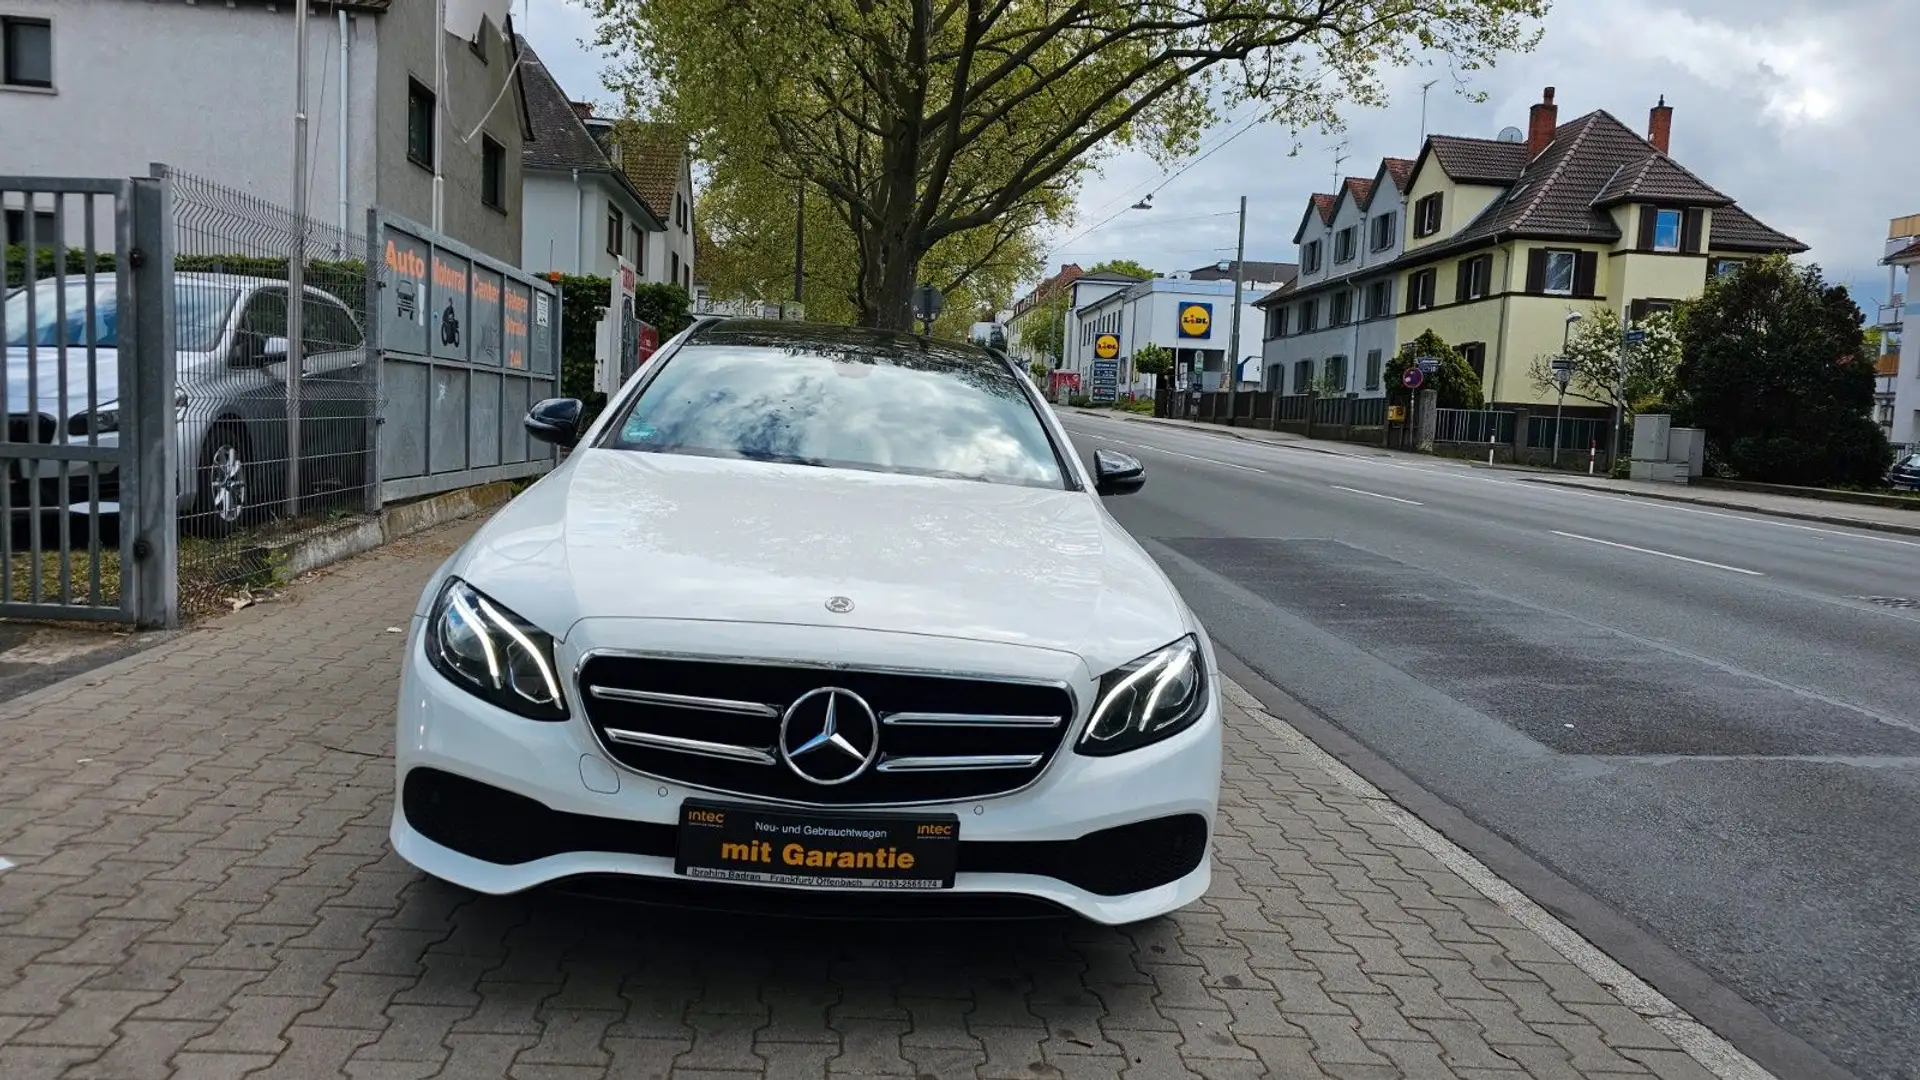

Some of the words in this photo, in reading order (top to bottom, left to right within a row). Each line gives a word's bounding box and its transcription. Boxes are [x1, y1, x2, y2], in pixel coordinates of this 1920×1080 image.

[385, 239, 425, 279] Auto
[688, 810, 725, 824] intec
[755, 821, 780, 832] Neu-
[782, 824, 801, 834] und
[803, 825, 887, 839] Gebrauchtwagen
[917, 825, 952, 836] intec
[721, 839, 772, 863] mit
[782, 843, 915, 869] Garantie
